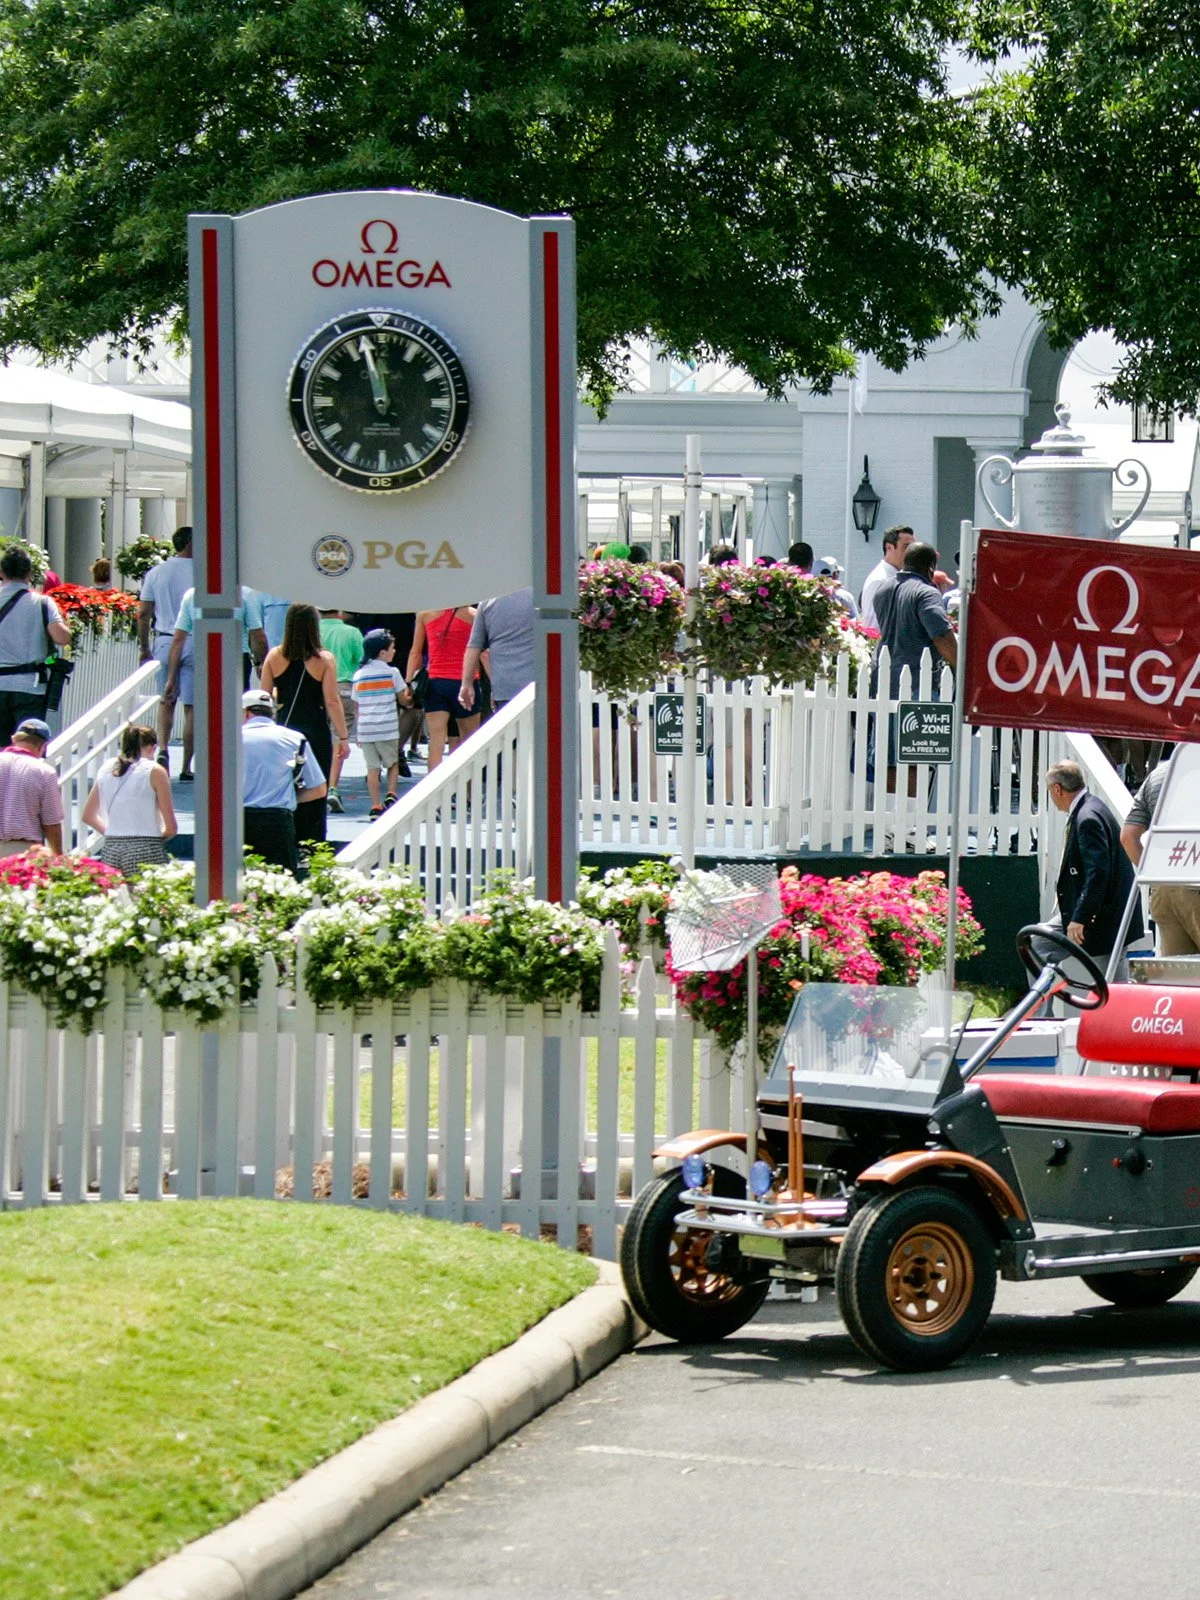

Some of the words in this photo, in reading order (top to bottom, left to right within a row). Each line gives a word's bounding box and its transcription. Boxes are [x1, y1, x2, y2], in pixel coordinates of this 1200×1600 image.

[312, 260, 452, 289] OMEGA
[300, 349, 318, 370] 50
[300, 430, 317, 451] 40
[442, 432, 459, 452] 20
[369, 477, 392, 487] 30
[318, 552, 348, 560] PGA
[362, 540, 464, 569] PGA
[675, 716, 702, 725] ZE
[923, 714, 950, 723] Wi-Fi
[921, 725, 950, 734] ZONE
[1131, 1016, 1184, 1036] OMEGA
